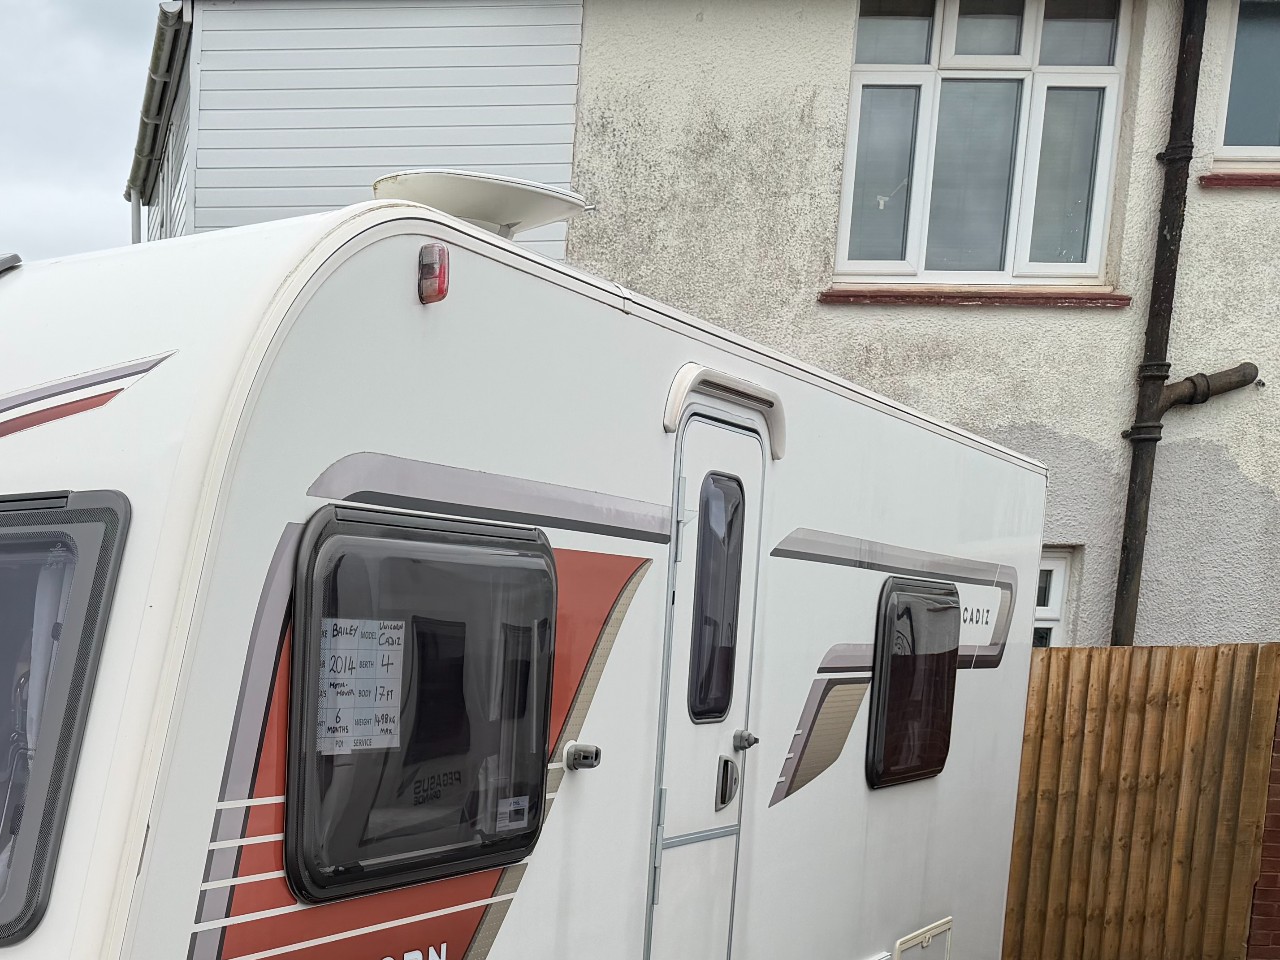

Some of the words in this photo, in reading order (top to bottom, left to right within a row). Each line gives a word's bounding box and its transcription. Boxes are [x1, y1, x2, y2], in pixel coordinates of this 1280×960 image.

[962, 606, 990, 625] CADIZ
[332, 623, 358, 637] BAILEY
[360, 630, 377, 640] MODEL
[378, 632, 402, 646] CADIZ
[329, 654, 356, 675] 2014
[359, 660, 375, 669] BERTH
[381, 654, 394, 673] 4
[358, 689, 372, 697] BODY
[335, 708, 342, 724] 6
[354, 718, 372, 727] WEIGHT
[326, 724, 349, 734] MONTHS
[353, 738, 372, 747] SERVICE
